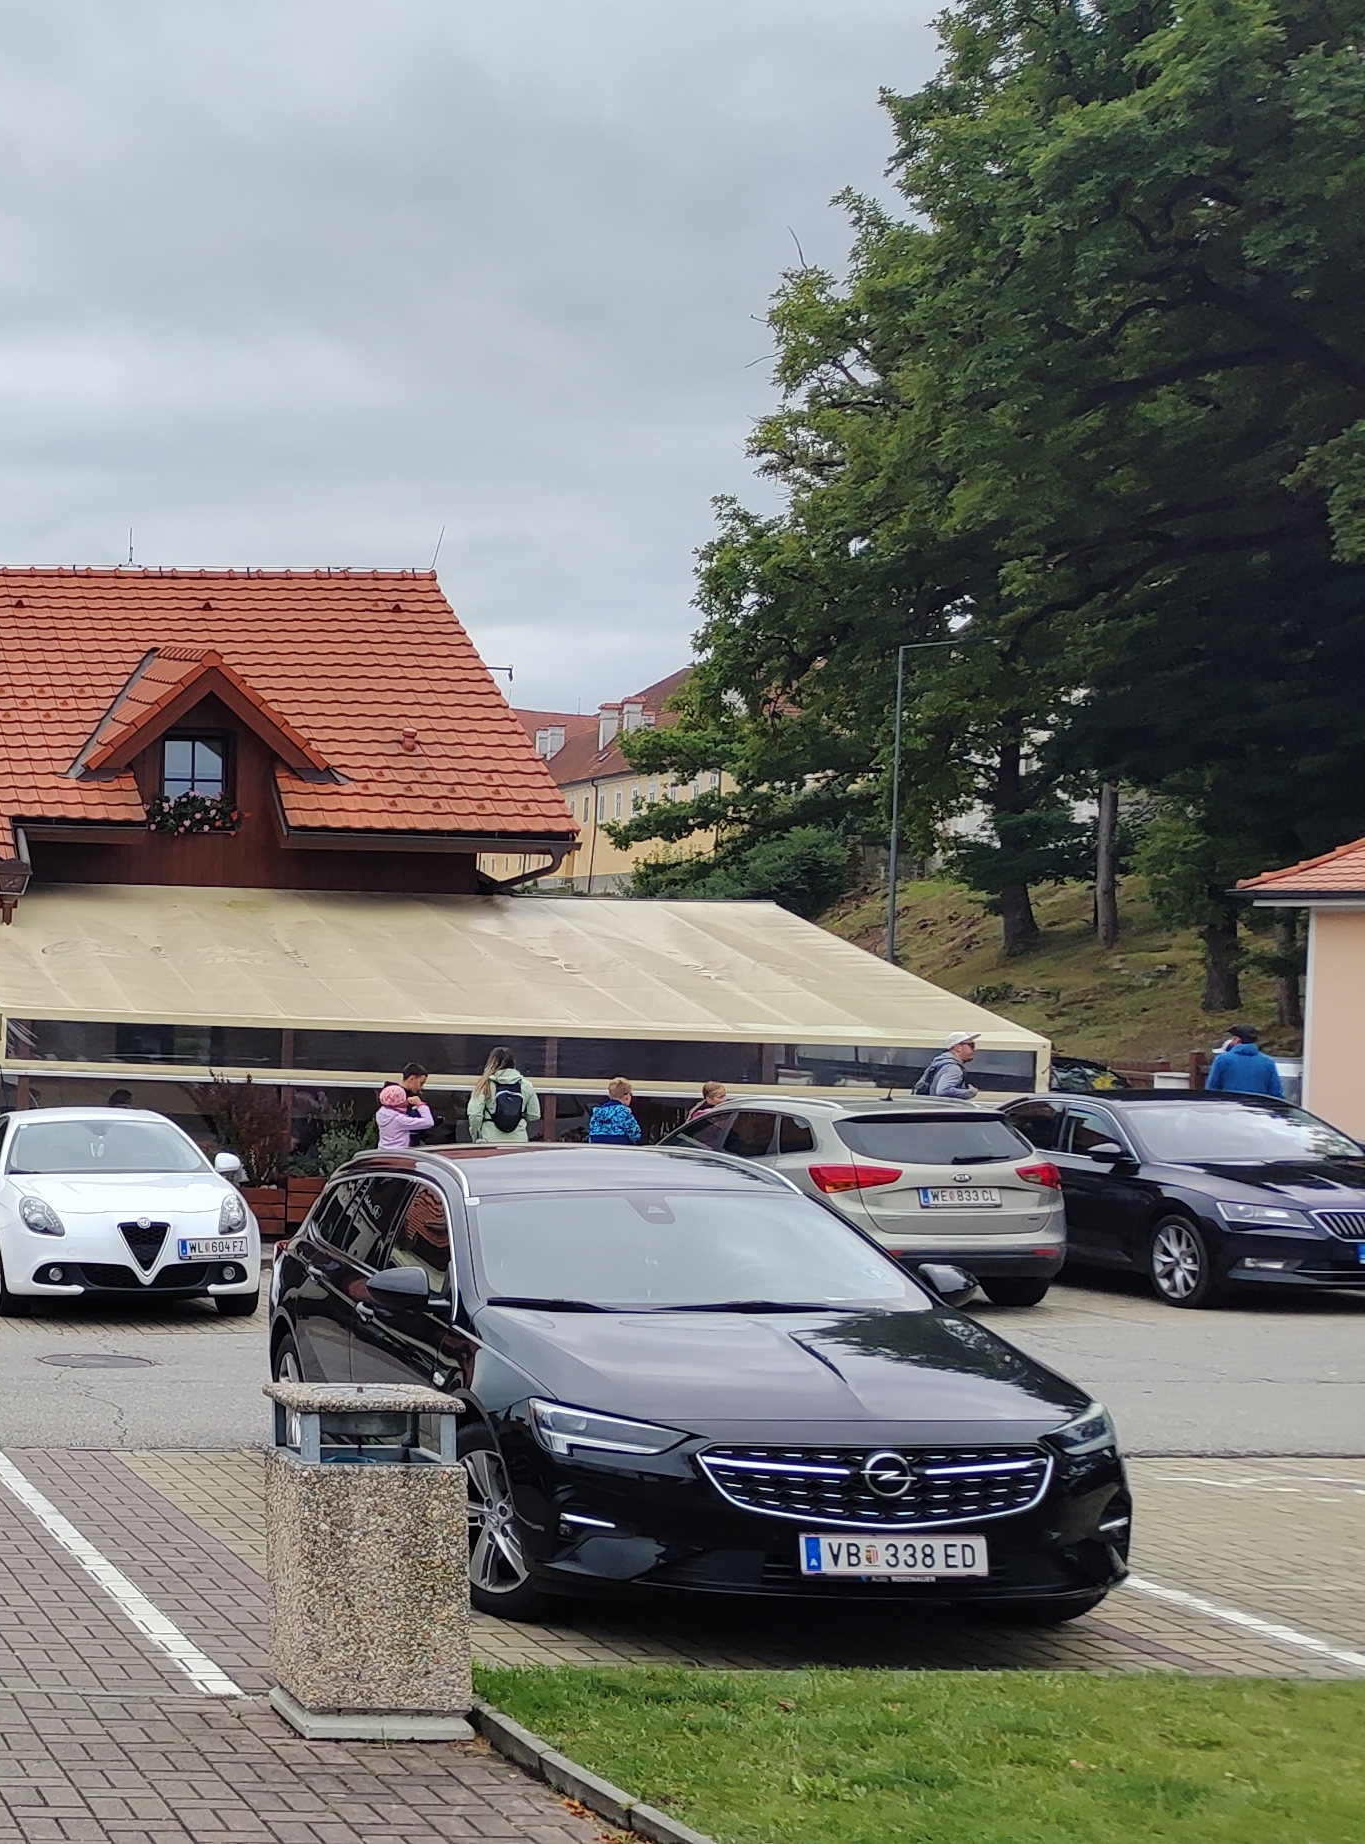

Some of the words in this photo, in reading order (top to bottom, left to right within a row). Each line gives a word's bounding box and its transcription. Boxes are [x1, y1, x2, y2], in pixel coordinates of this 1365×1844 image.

[930, 1190, 948, 1202] WE
[957, 1190, 979, 1202] 833
[981, 1190, 997, 1202] CL
[188, 1242, 204, 1254] WL
[211, 1241, 231, 1253] 604
[232, 1240, 245, 1252] FZ
[827, 1541, 862, 1568] VB
[884, 1543, 936, 1569] 338
[943, 1543, 977, 1569] ED
